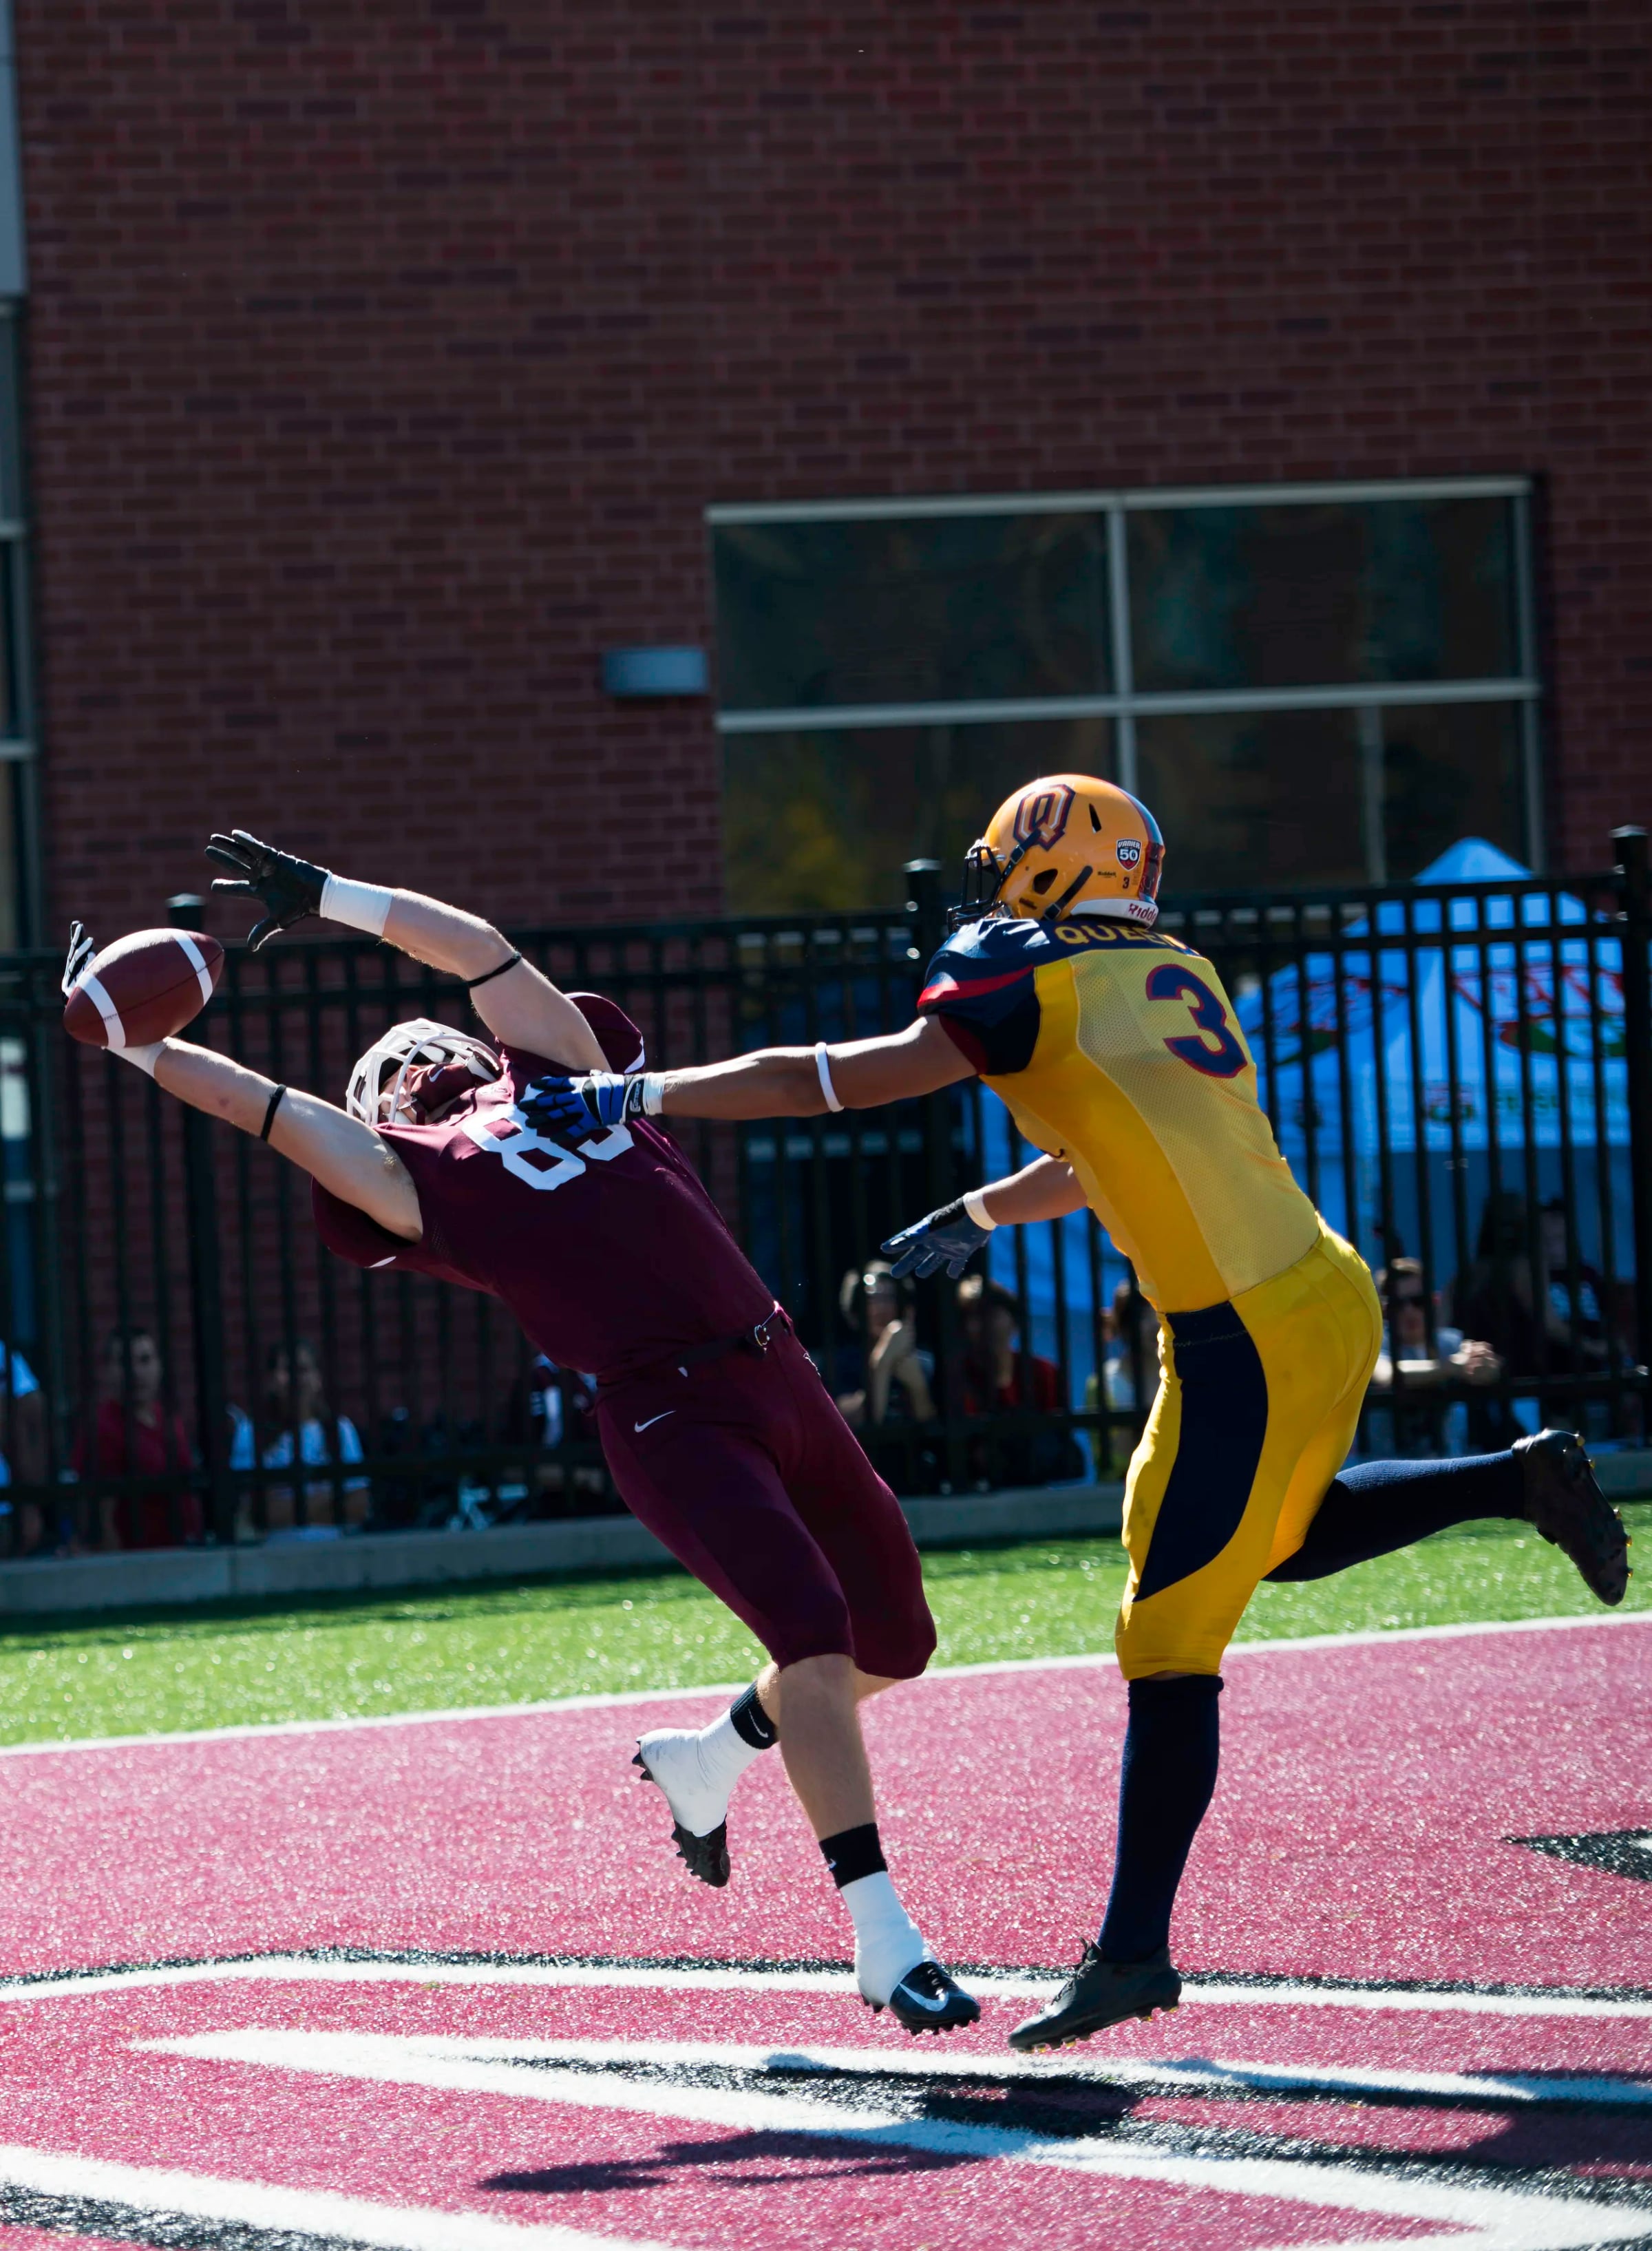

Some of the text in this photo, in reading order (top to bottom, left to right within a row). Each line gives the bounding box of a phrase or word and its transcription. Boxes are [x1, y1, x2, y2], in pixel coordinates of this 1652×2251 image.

[1013, 783, 1076, 852] Q
[1118, 840, 1141, 849] VANIER
[1119, 849, 1139, 861] 50
[1122, 876, 1130, 889] 3
[1145, 964, 1247, 1079] 3
